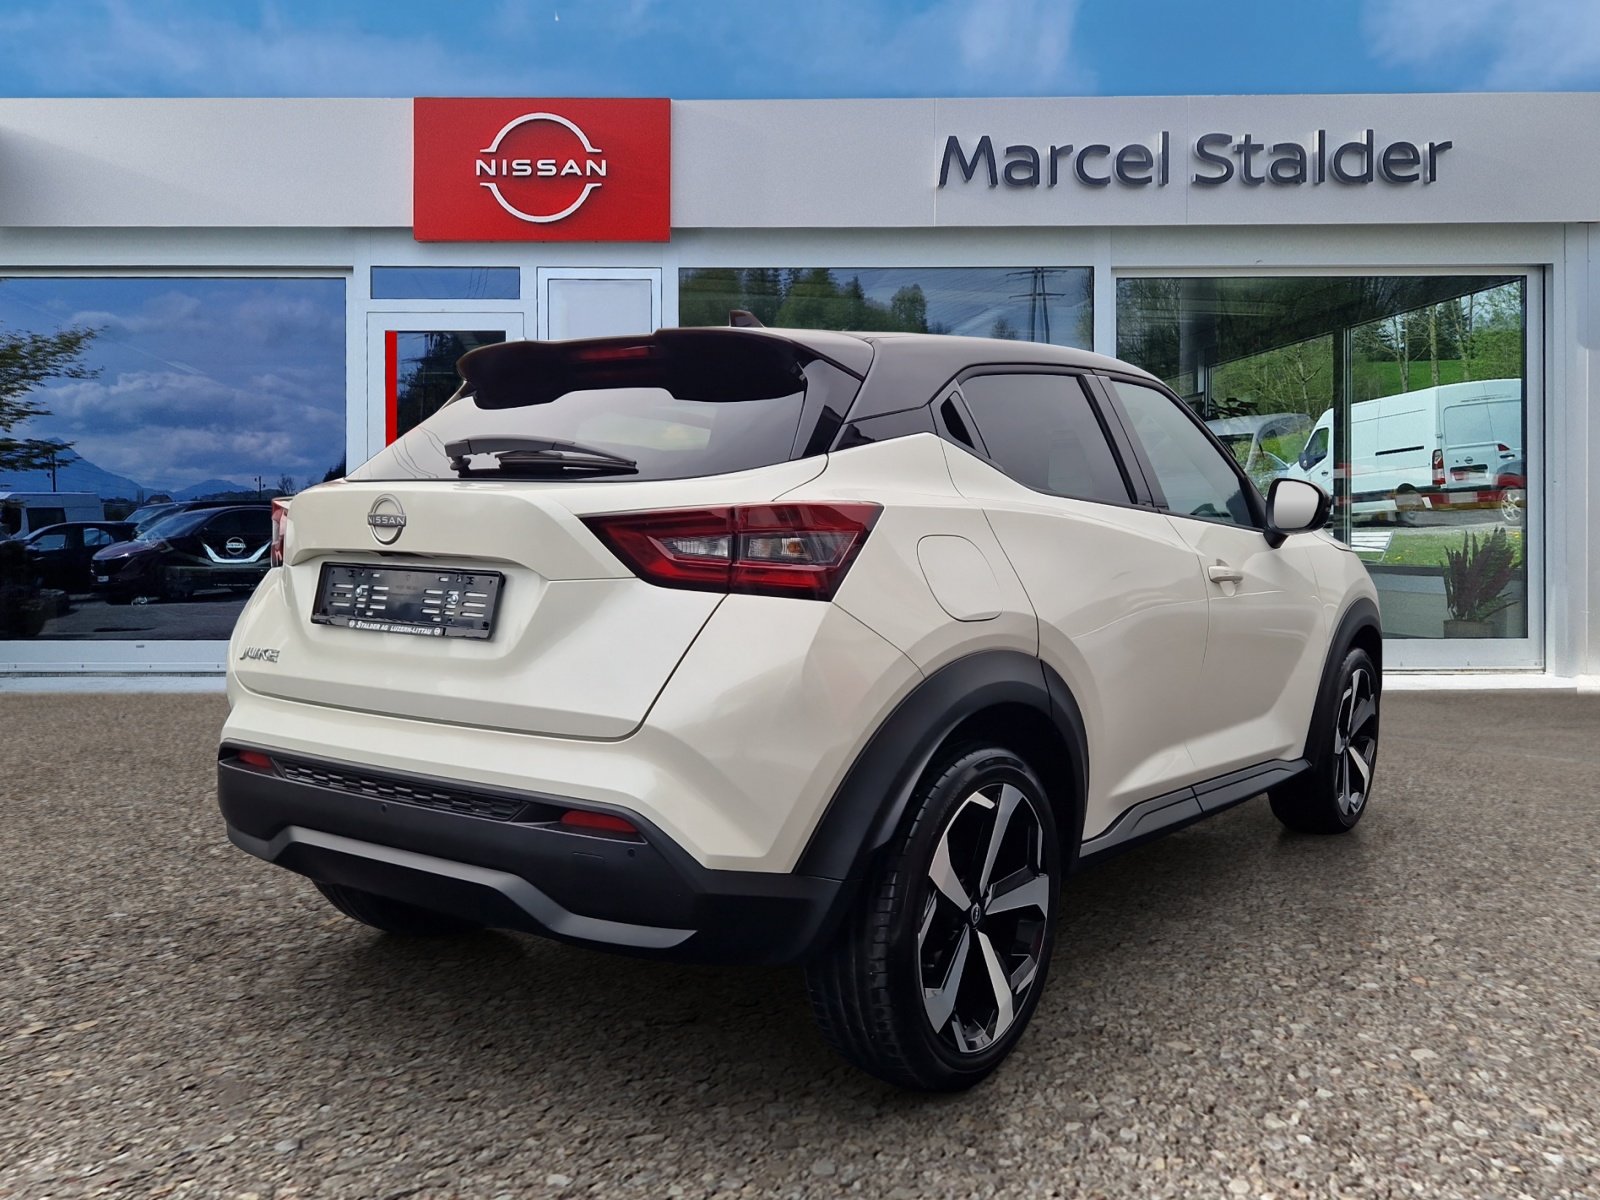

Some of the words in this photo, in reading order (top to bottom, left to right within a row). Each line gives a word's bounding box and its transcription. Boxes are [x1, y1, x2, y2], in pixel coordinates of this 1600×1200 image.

[938, 131, 1170, 188] Marcel
[1191, 129, 1453, 186] Stalder
[475, 159, 607, 177] NISSAN
[368, 516, 405, 525] NISSAN
[240, 647, 280, 663] JUKE
